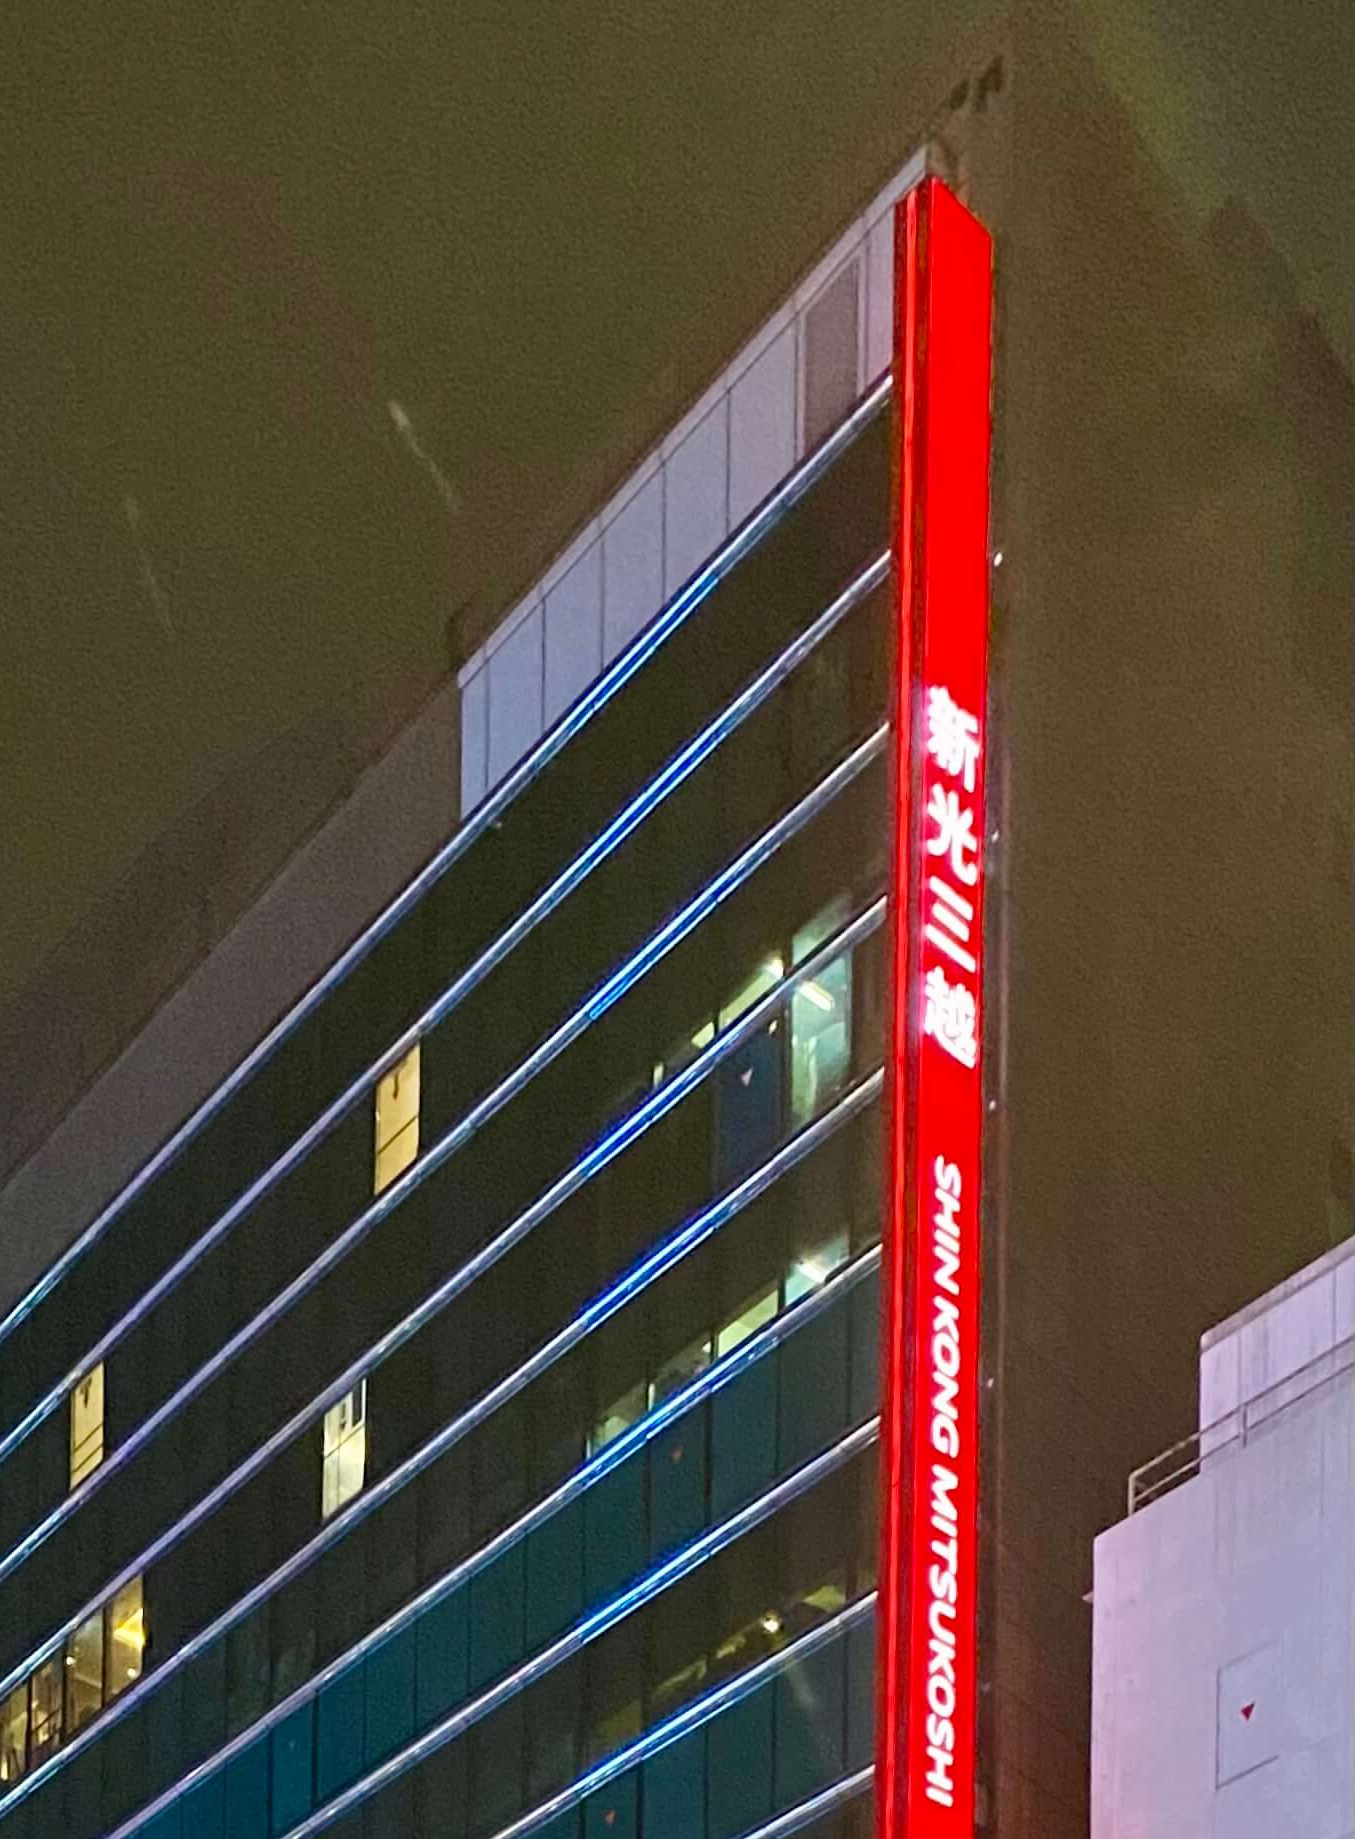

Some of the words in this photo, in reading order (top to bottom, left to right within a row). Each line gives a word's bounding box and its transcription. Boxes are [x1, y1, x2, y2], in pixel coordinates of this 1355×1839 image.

[925, 686, 980, 1069] 新光三越
[933, 1154, 962, 1296] SHIN
[930, 1296, 961, 1458] KONG
[925, 1464, 959, 1807] MITSUKOSHI
